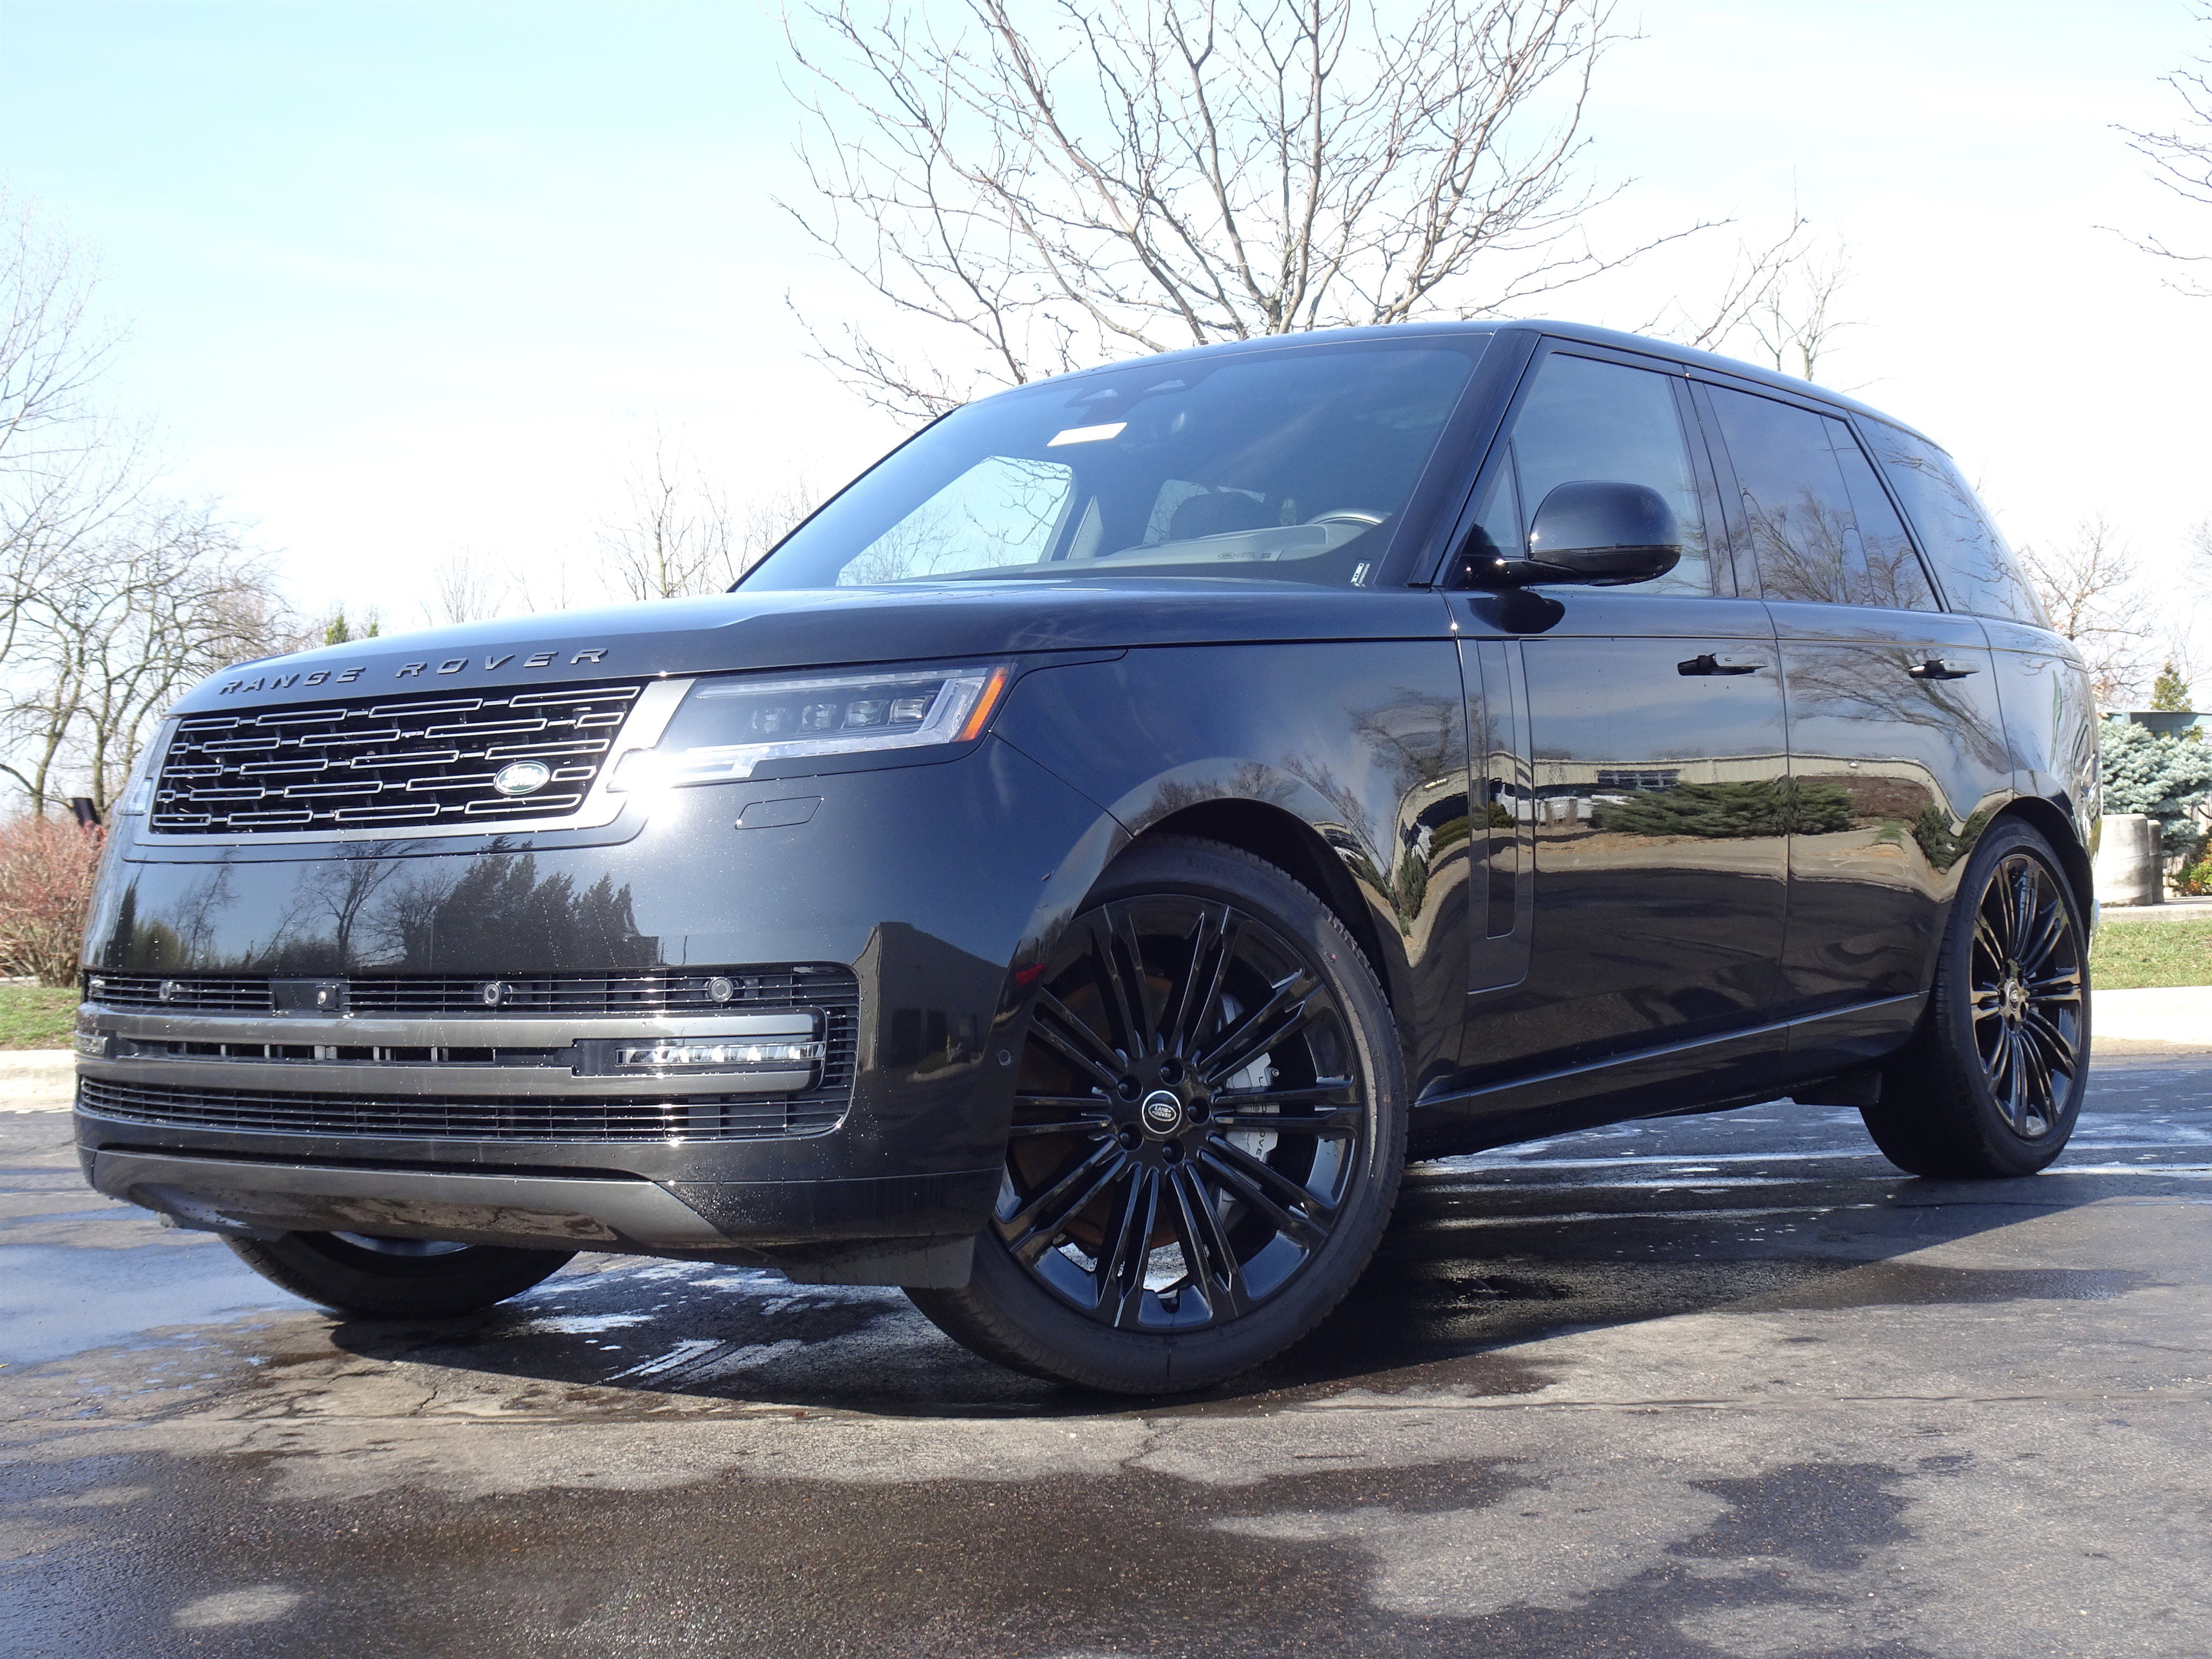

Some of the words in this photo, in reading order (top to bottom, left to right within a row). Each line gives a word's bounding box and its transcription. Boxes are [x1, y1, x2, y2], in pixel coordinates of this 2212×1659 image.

[218, 666, 366, 695] RANGE
[395, 647, 609, 678] ROVER
[1256, 1128, 1265, 1161] OVE
